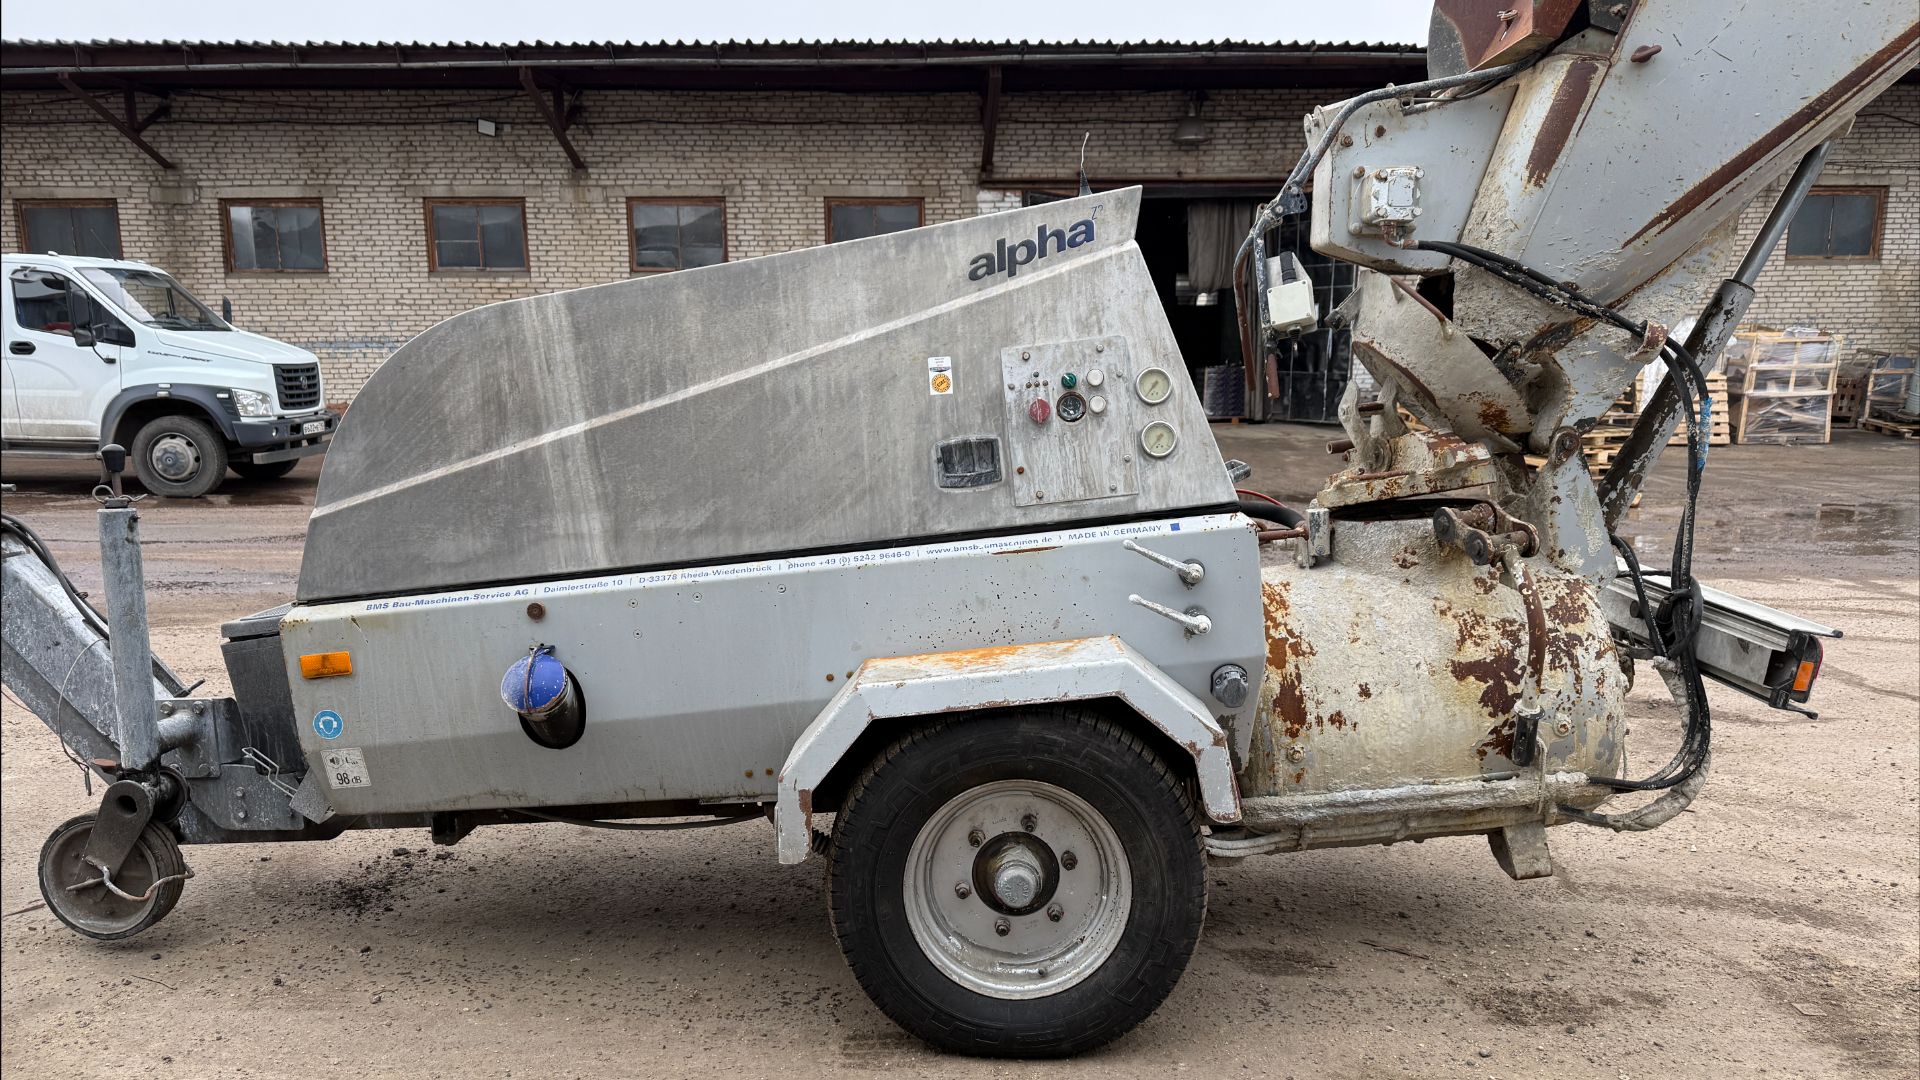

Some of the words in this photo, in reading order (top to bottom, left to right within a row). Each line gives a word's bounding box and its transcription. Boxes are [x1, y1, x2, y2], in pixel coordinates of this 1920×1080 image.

[968, 219, 1095, 281] alpha
[1068, 531, 1097, 541] MADE
[1100, 529, 1110, 537] IN
[1113, 524, 1162, 536] GERMANY
[787, 560, 816, 570] phone
[819, 558, 836, 566] +49
[639, 573, 678, 584] D-33378
[366, 602, 389, 611] BMS
[392, 591, 511, 608] Bau-Maschinen-Service
[514, 588, 529, 596] AG
[336, 772, 350, 785] 98
[351, 775, 362, 784] dB
